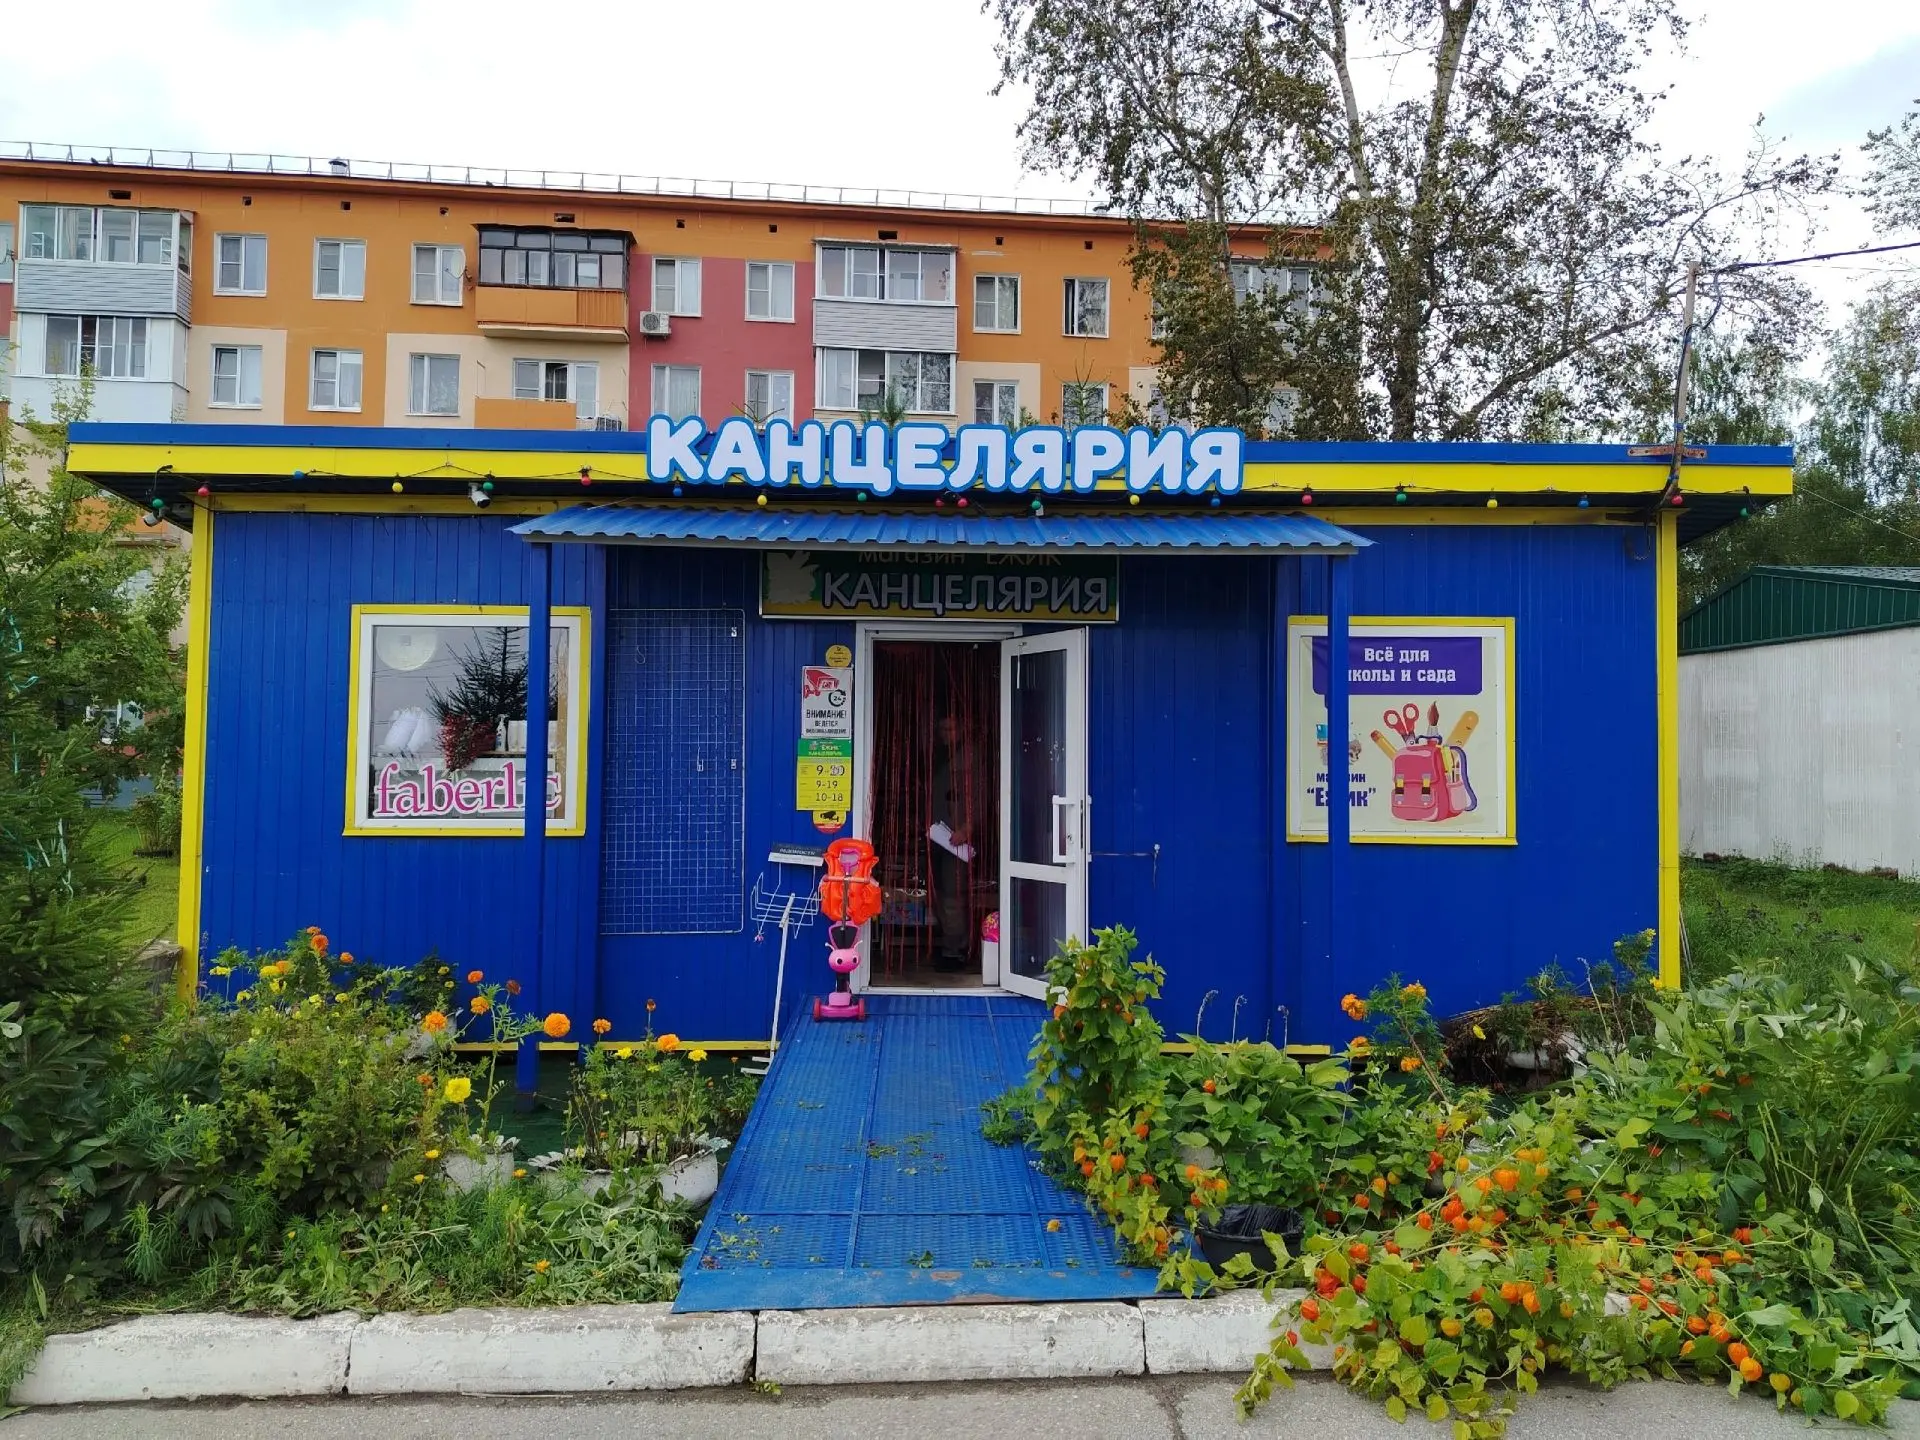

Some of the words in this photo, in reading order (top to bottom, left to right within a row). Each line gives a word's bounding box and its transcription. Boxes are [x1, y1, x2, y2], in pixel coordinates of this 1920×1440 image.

[649, 416, 1242, 495] КАНЦЕЛЯРИЯ
[823, 572, 1108, 614] КАНЦЕЛЯРИЯ
[1364, 647, 1394, 662] Всё
[1399, 649, 1430, 663] для
[1348, 669, 1395, 682] колы
[1401, 669, 1411, 682] и
[1417, 669, 1456, 683] сада
[806, 709, 847, 719] ВНИМАНИЕ!
[374, 762, 561, 815] faberlc
[816, 792, 844, 802] 10-18
